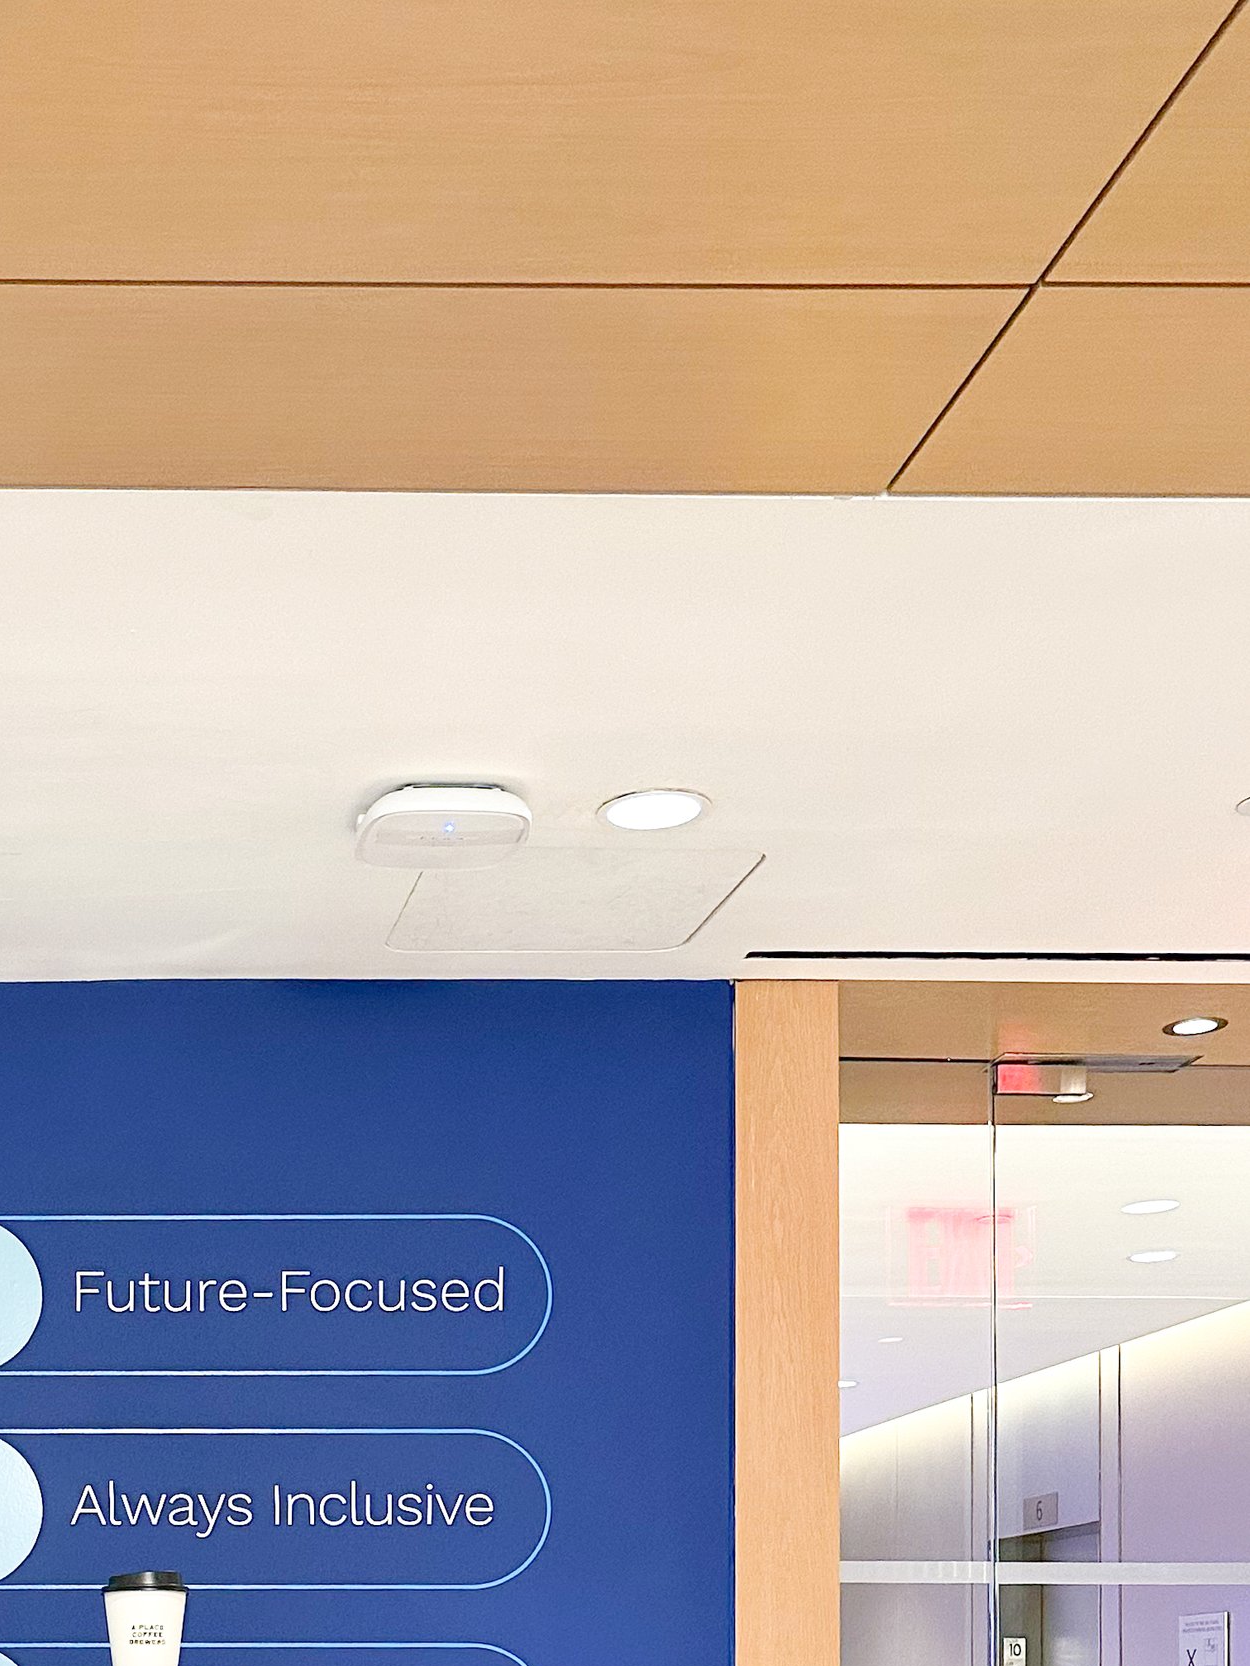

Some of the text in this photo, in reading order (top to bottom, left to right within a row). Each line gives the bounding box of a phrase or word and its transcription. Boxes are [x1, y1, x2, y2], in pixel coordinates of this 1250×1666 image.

[74, 1266, 505, 1313] Future-Focused
[70, 1480, 495, 1538] Always Inclusive
[1034, 1499, 1044, 1522] 6
[1009, 1643, 1022, 1657] 10
